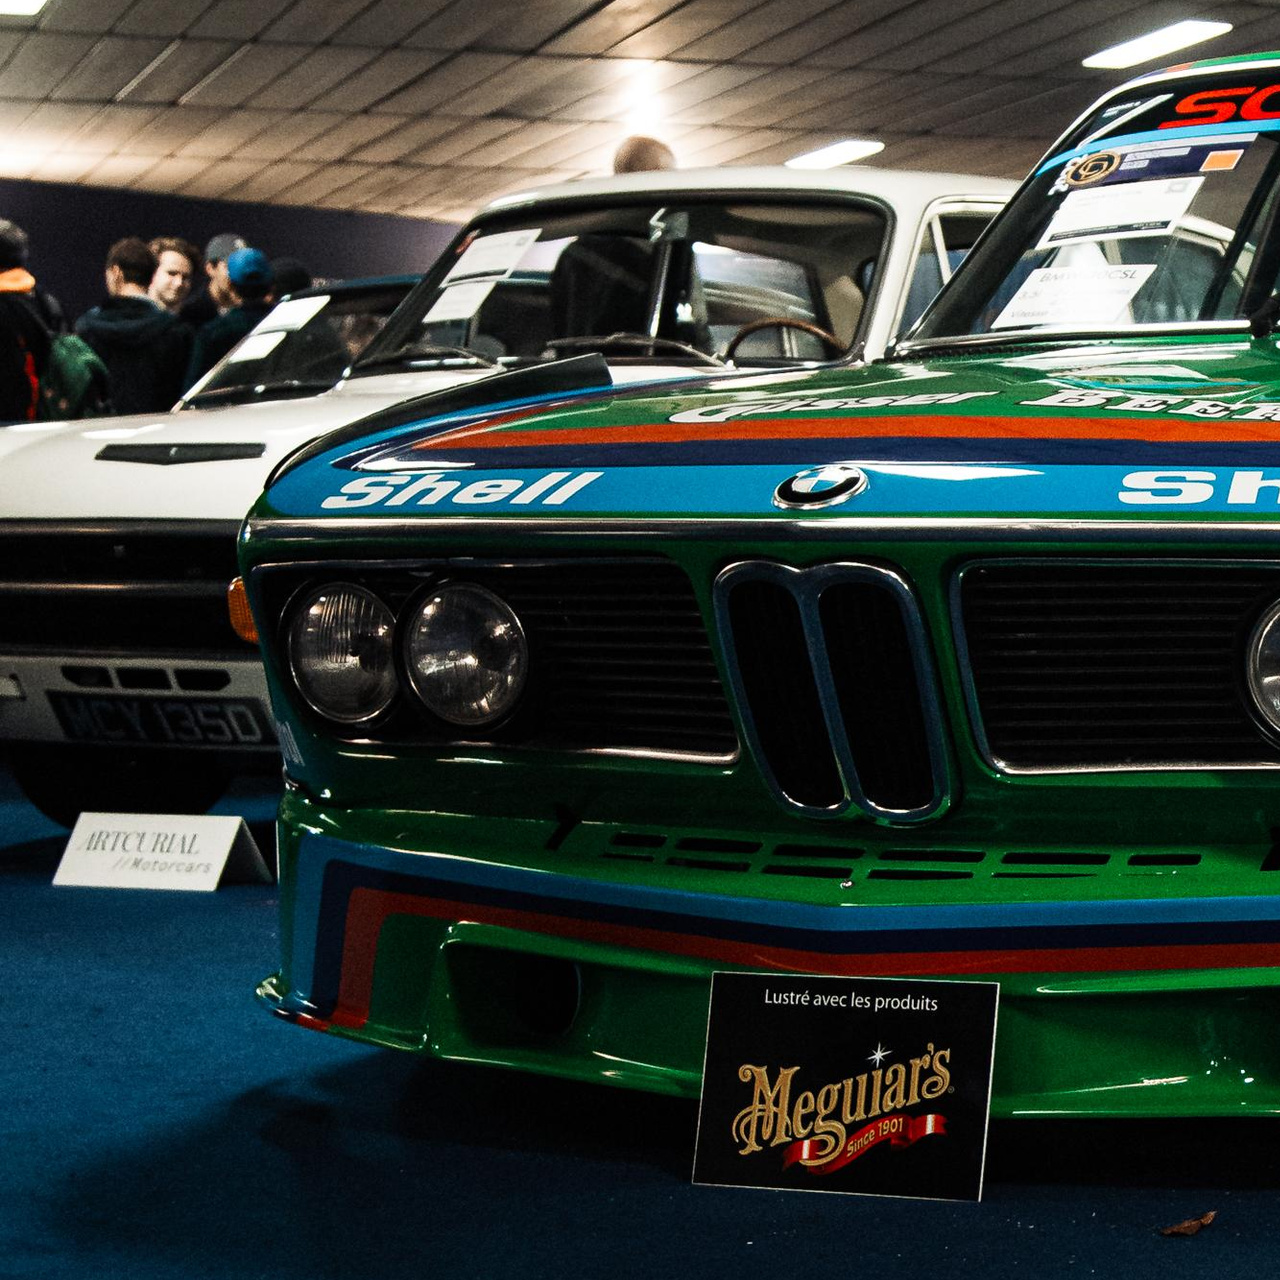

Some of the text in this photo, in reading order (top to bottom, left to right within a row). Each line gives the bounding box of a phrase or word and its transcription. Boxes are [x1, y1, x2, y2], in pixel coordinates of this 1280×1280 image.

[320, 472, 605, 509] Shell
[80, 830, 202, 855] ARTCURIAL
[764, 988, 939, 1012] Lustré avec les produits
[732, 1042, 951, 1167] Meguiar's
[846, 1116, 904, 1157] Since 1901
